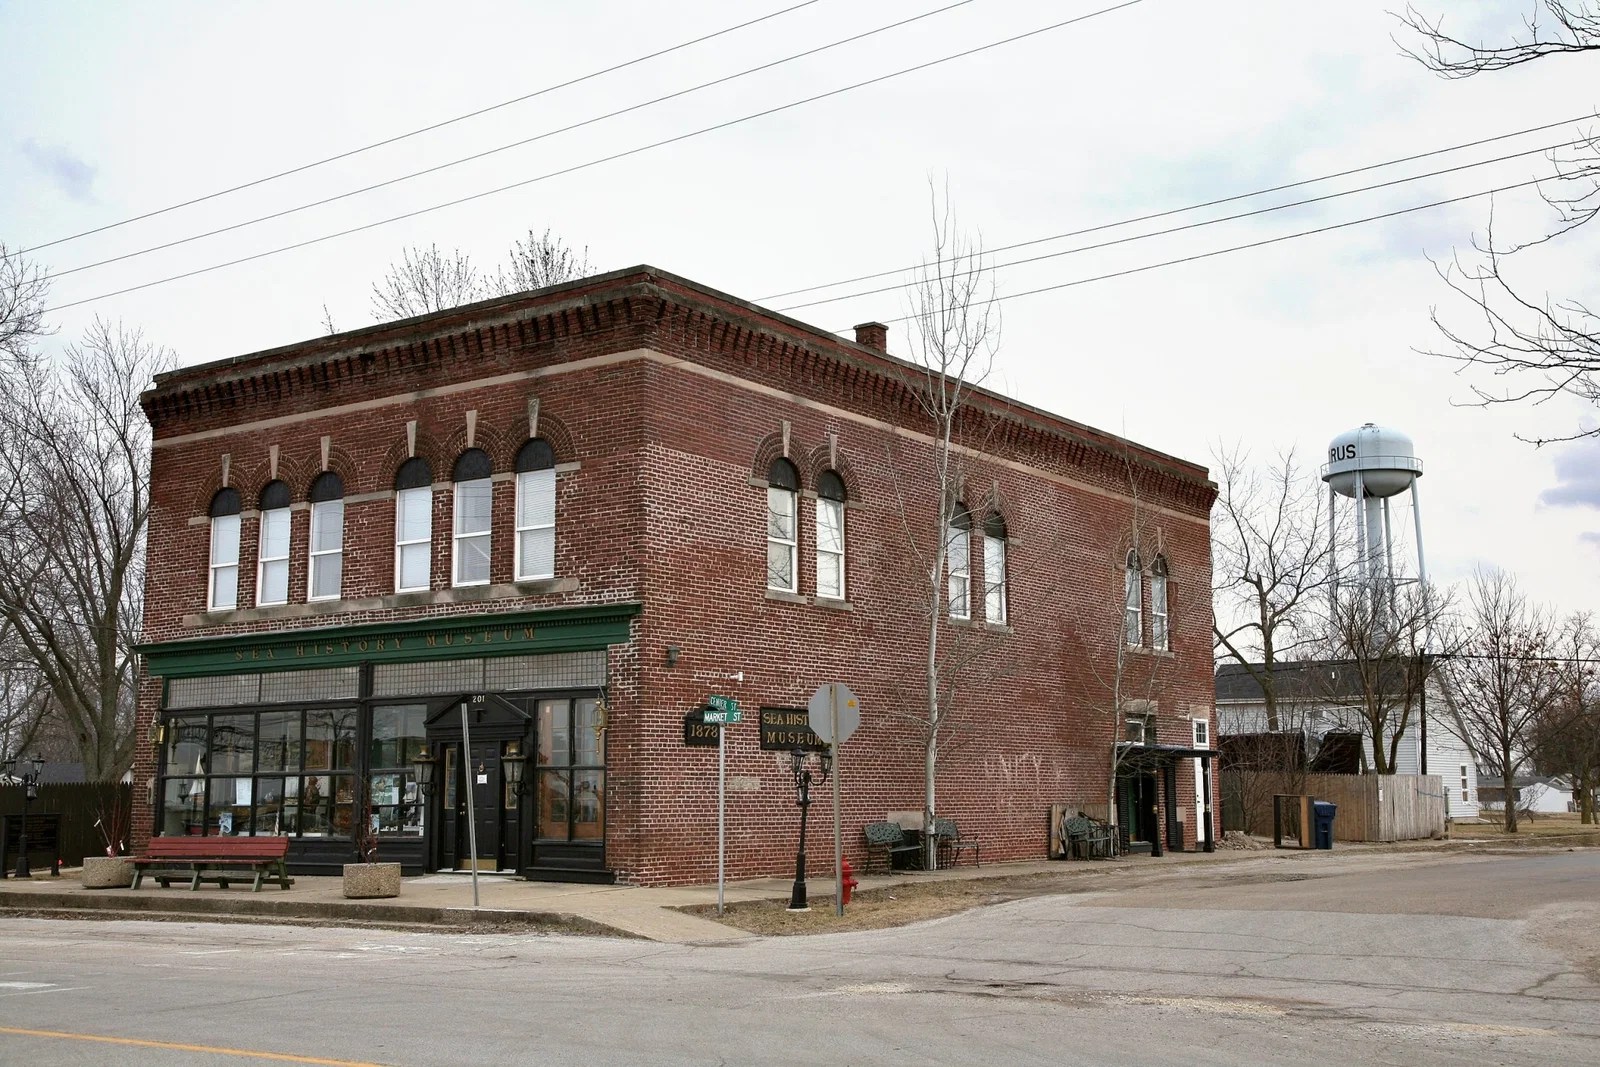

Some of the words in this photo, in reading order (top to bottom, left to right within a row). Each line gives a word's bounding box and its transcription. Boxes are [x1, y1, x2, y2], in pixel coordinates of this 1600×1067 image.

[1328, 444, 1356, 463] RUS
[235, 648, 275, 661] SEA
[296, 638, 403, 656] HISTORY
[426, 627, 536, 646] MUSEUM
[472, 695, 485, 703] 201
[704, 712, 728, 722] MARKET
[733, 712, 742, 721] ST
[763, 712, 784, 725] SEA
[786, 713, 809, 726] HIST
[690, 724, 718, 738] 1878
